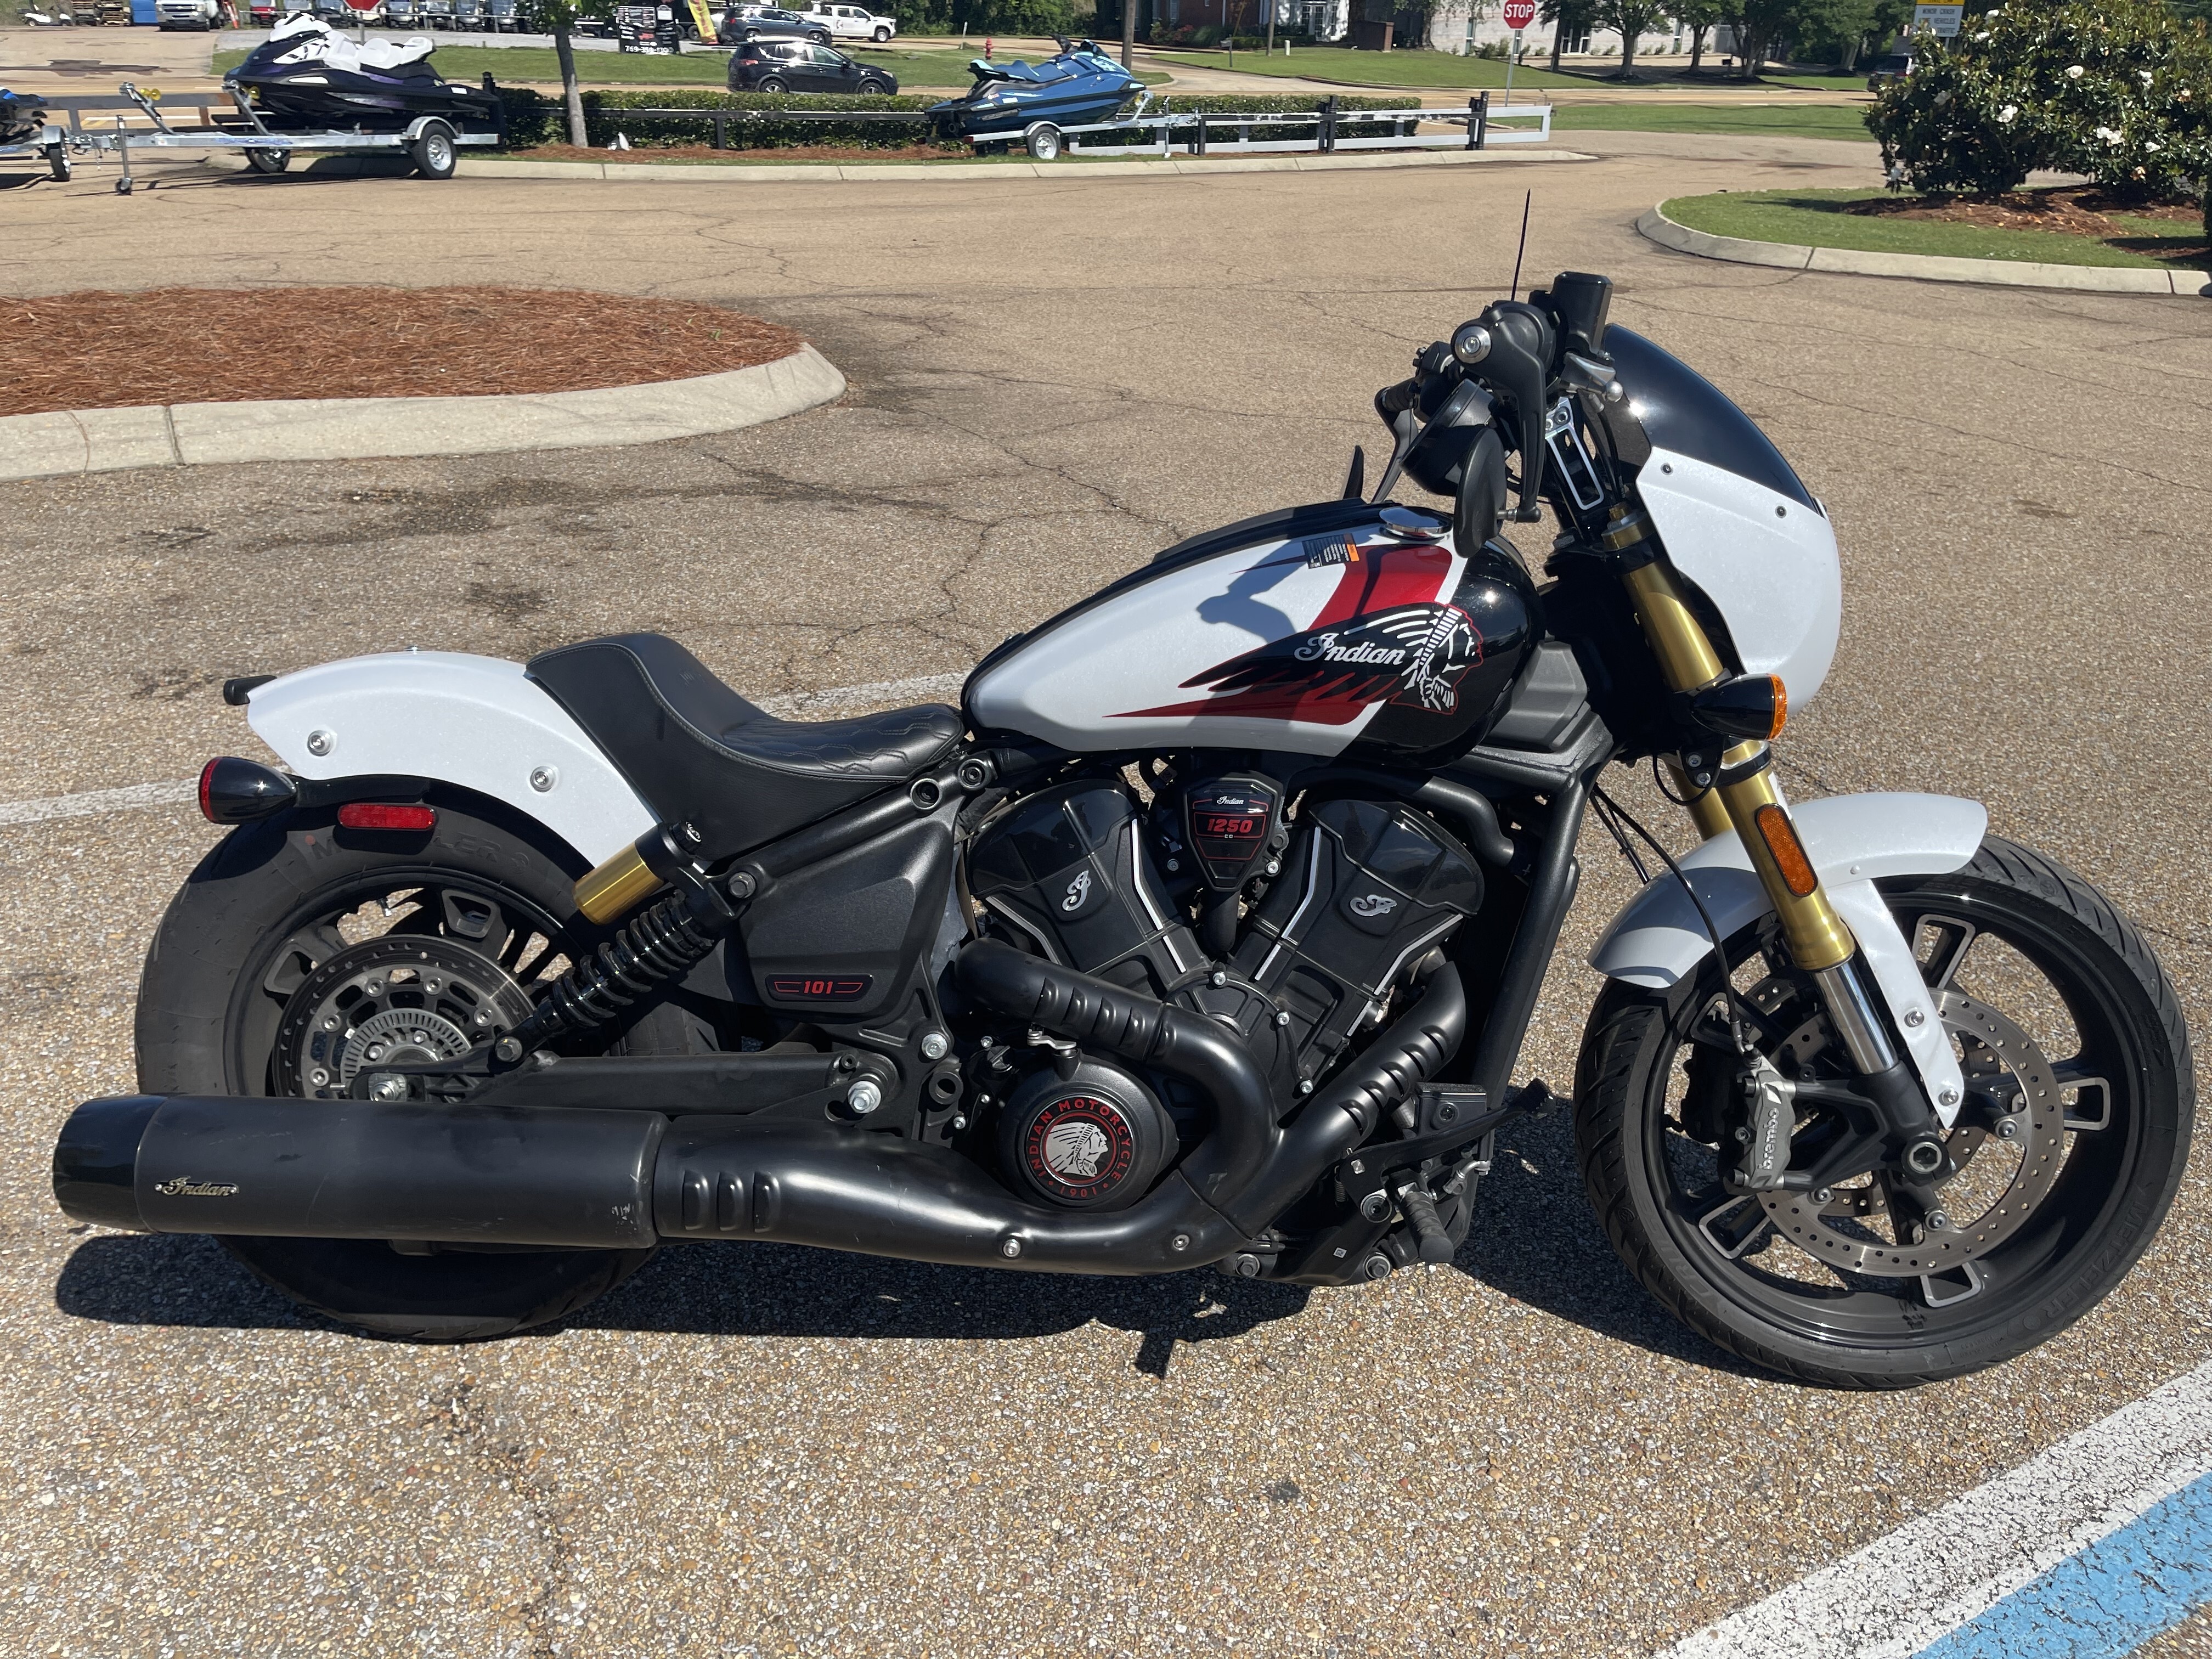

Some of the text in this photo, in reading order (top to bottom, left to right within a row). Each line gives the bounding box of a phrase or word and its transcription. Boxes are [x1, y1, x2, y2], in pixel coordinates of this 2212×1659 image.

[1505, 4, 1533, 18] STOP
[1294, 633, 1406, 665] Indian
[1216, 795, 1244, 805] Indian
[1207, 819, 1253, 833] 1250
[804, 980, 833, 994] 101
[1028, 1098, 1131, 1181] INDIAN MOTORCYCLE
[1757, 1107, 1780, 1170] brembo
[161, 1175, 231, 1197] Indian
[1059, 1186, 1097, 1198] 1901
[2041, 1200, 2149, 1319] METZELER
